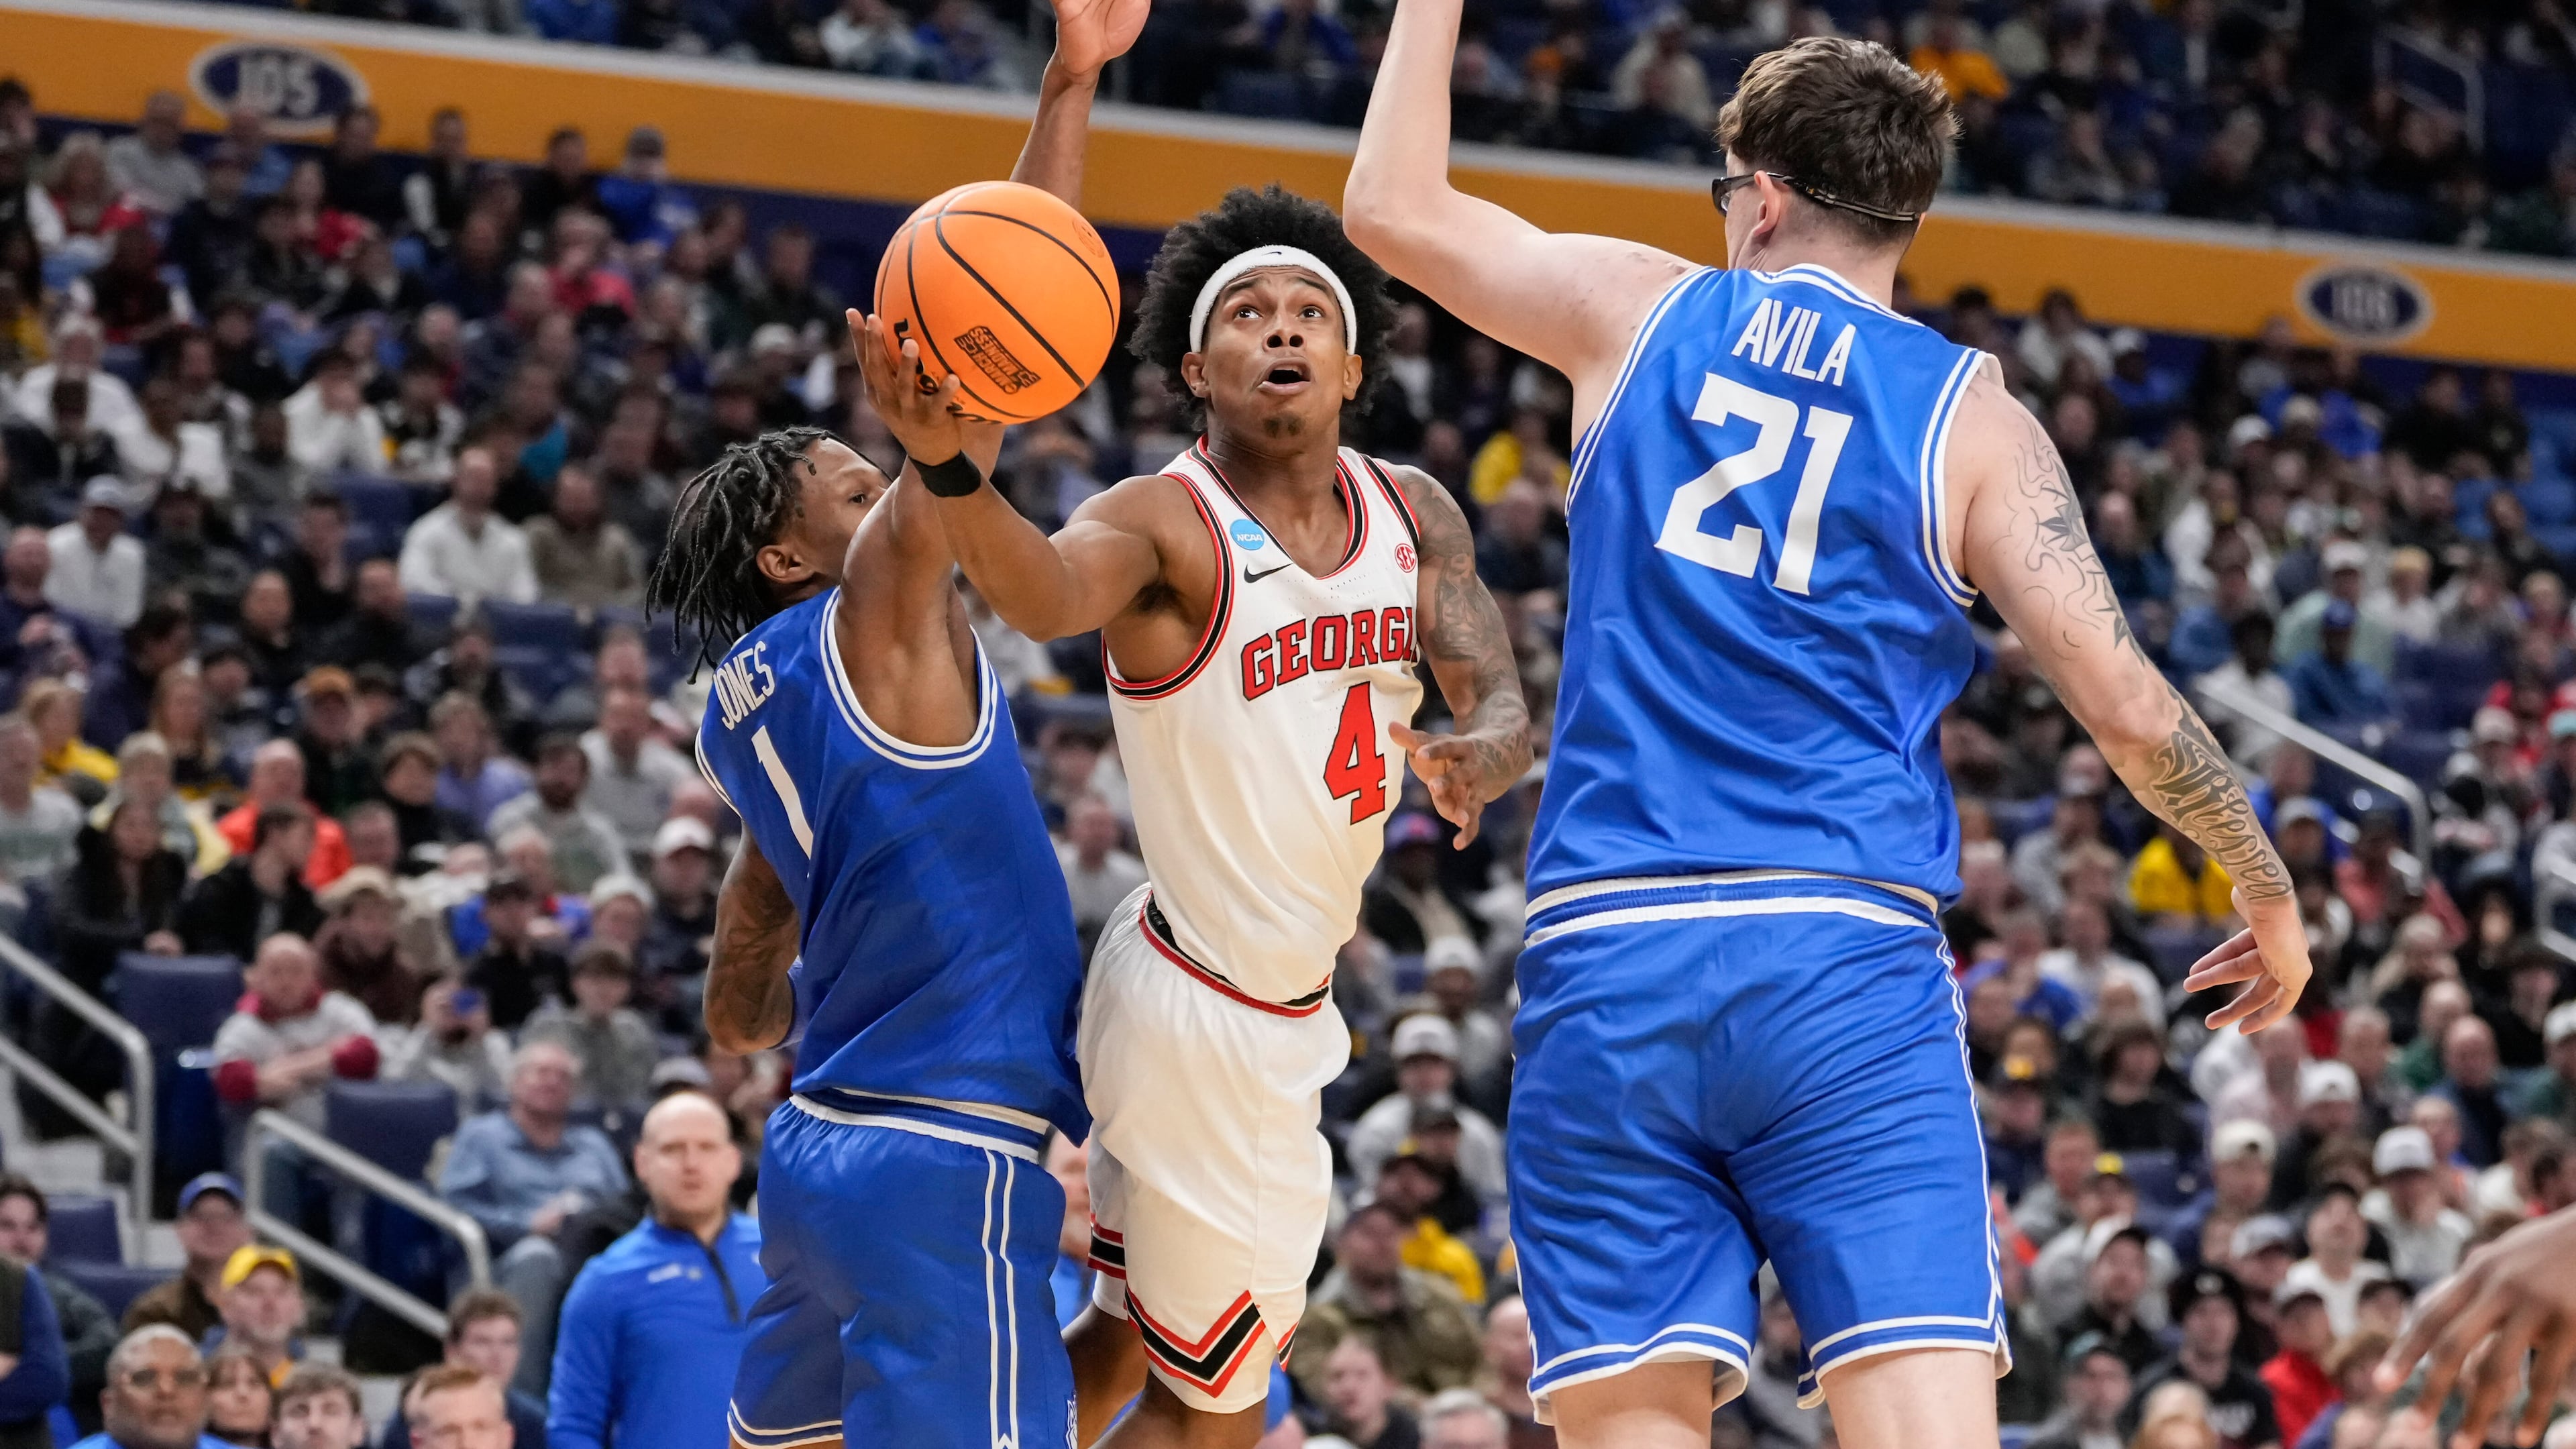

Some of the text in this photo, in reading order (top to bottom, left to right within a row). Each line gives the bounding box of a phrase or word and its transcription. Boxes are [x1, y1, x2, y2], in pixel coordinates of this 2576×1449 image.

[971, 327, 1020, 376] MADNESS
[973, 351, 1016, 386] MARCH
[1731, 298, 1857, 387] AVILA
[1654, 372, 1854, 596] 21
[1236, 533, 1263, 541] NCAA
[1397, 546, 1415, 570] SEC
[712, 640, 775, 731] JONES
[751, 725, 814, 861] 1
[1324, 681, 1385, 825] 4
